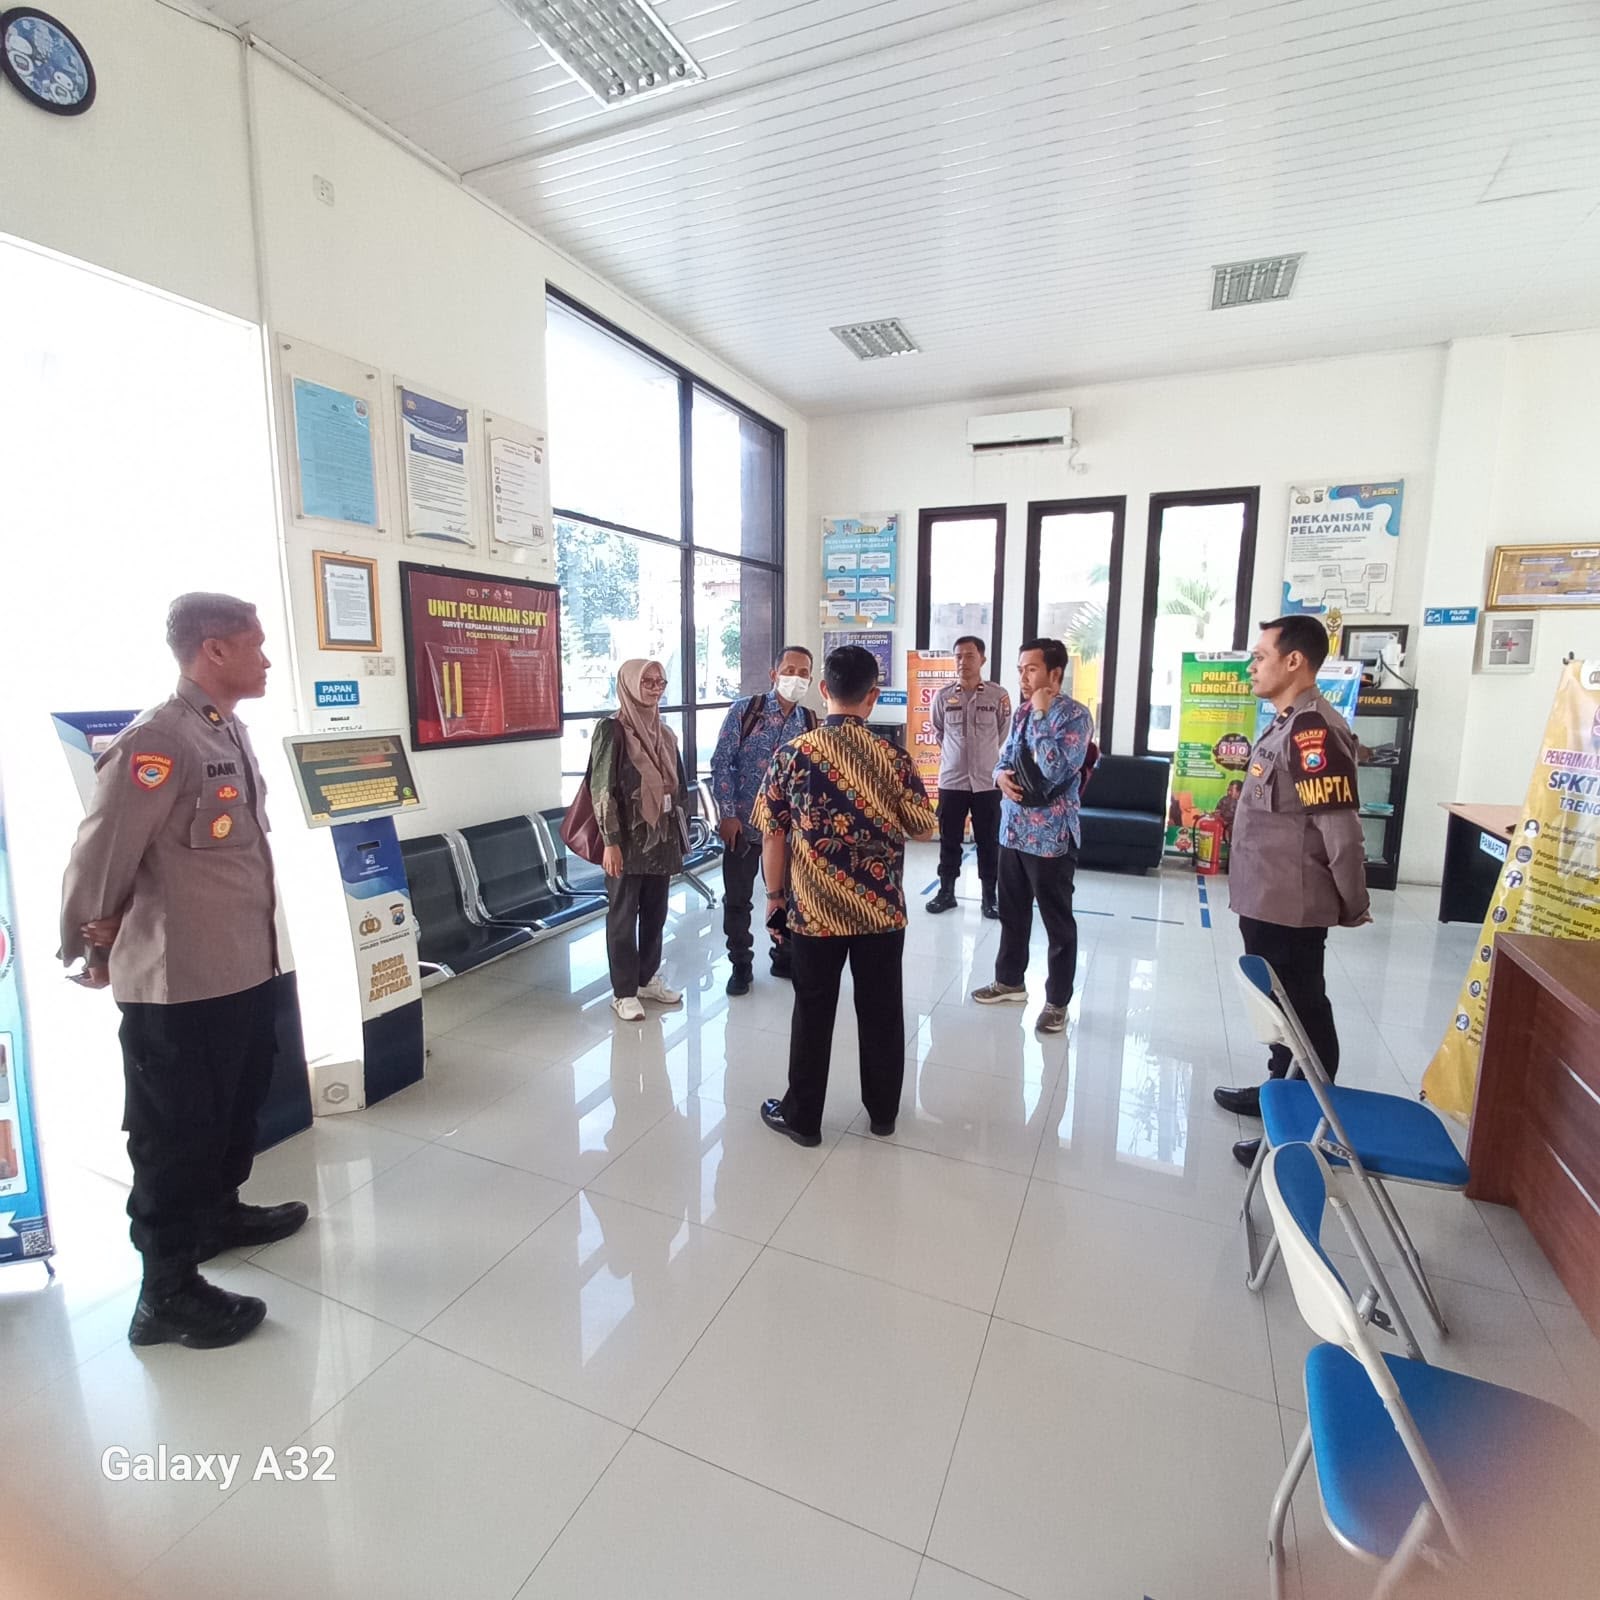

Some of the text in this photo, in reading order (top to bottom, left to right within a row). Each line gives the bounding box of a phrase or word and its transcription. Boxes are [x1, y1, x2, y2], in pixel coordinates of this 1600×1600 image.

[1291, 512, 1374, 524] MEKANISME
[1290, 523, 1371, 535] PELAYANAN
[428, 599, 548, 627] UNIT PELAYANAN SPKT
[1203, 671, 1238, 681] POLRES
[322, 685, 352, 693] PAPAN
[1190, 682, 1249, 694] TRENGGALEK
[319, 693, 358, 703] BRAILLE
[1358, 696, 1393, 705] FIKASI
[1220, 745, 1246, 755] 110
[207, 762, 237, 778] DANI
[1548, 771, 1598, 794] SPKT
[372, 954, 404, 974] MESIN
[371, 965, 409, 988] NOMOR
